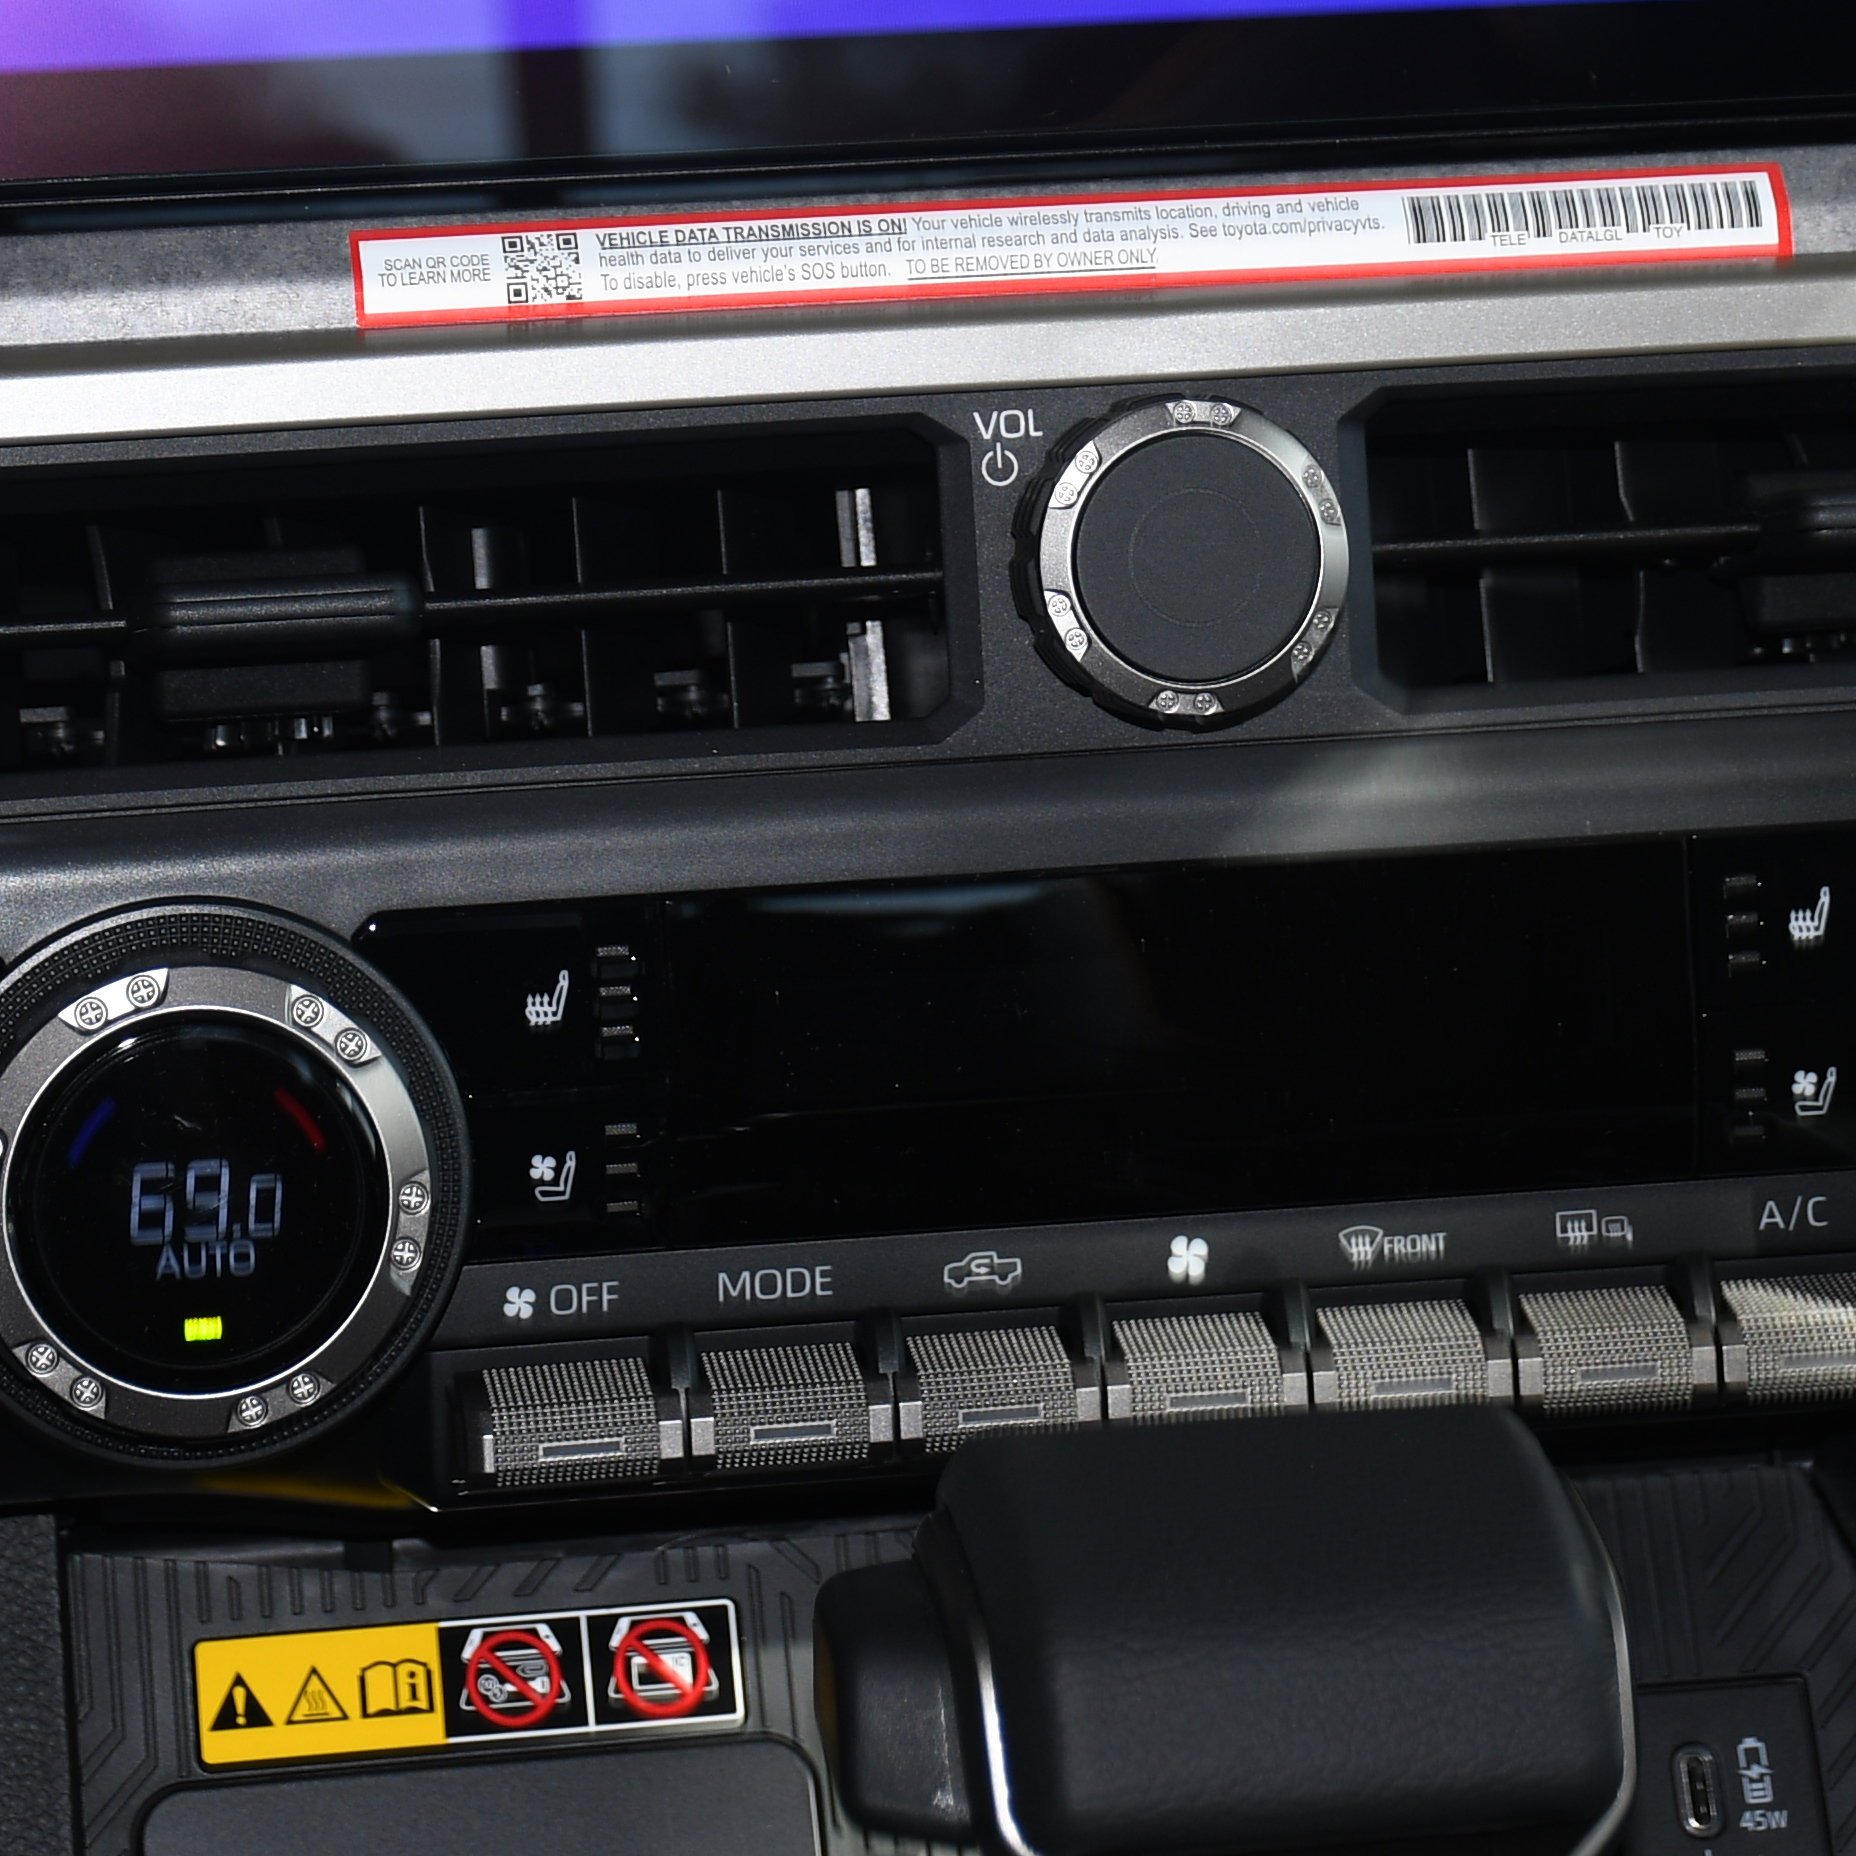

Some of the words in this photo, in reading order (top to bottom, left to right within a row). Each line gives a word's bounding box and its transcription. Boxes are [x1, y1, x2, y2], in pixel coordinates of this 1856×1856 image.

[596, 229, 670, 248] VEHICLE
[674, 227, 719, 244] DATA
[722, 220, 852, 242] TRANSMISSION
[857, 219, 873, 235] IS
[877, 217, 907, 234] ON!
[911, 216, 946, 232] Your
[951, 213, 1003, 230] vehicle
[1007, 210, 1080, 227] wirelessly
[1084, 206, 1152, 223] transmits
[1155, 204, 1218, 221] location,
[1223, 201, 1271, 219] driving
[1276, 199, 1303, 215] and
[1308, 196, 1360, 213] vehicle
[1491, 233, 1527, 247] TELE
[1558, 228, 1623, 244] DATALGL
[1652, 225, 1685, 240] TOY
[598, 250, 645, 268] health
[649, 248, 683, 265] data
[687, 248, 702, 263] to
[707, 245, 757, 262] deliver
[761, 245, 794, 263] your
[799, 240, 861, 257] services
[865, 237, 893, 253] and
[897, 236, 917, 252] for
[921, 233, 977, 251] internal
[981, 230, 1045, 248] research
[1050, 228, 1078, 245] and
[1082, 227, 1115, 243] data
[1119, 224, 1185, 244] analysis.
[1188, 222, 1218, 239] See
[1222, 215, 1386, 240] toyota.com/privacyvts.
[378, 272, 397, 288] TO
[400, 270, 447, 286] LEARN
[450, 267, 492, 284] MORE
[383, 256, 422, 272] SCAN
[425, 255, 448, 270] QR
[450, 253, 491, 268] CODE
[600, 273, 619, 292] To
[623, 271, 682, 291] disable,
[687, 270, 728, 292] press
[732, 264, 796, 285] vehicle's
[800, 261, 836, 281] SOS
[840, 260, 892, 279] button.
[905, 258, 927, 276] TO
[930, 257, 951, 274] BE
[955, 253, 1030, 273] REMOVED
[1033, 252, 1054, 269] BY
[1056, 249, 1115, 267] OWNER
[972, 408, 1044, 441] VOL
[129, 1157, 284, 1247] 69.0
[1758, 1195, 1830, 1232] A/C
[155, 1240, 256, 1282] AUTO
[1383, 1231, 1447, 1257] FRONT
[548, 1280, 621, 1317] OFF
[717, 1264, 834, 1304] MODE
[1739, 1809, 1789, 1832] 45W
